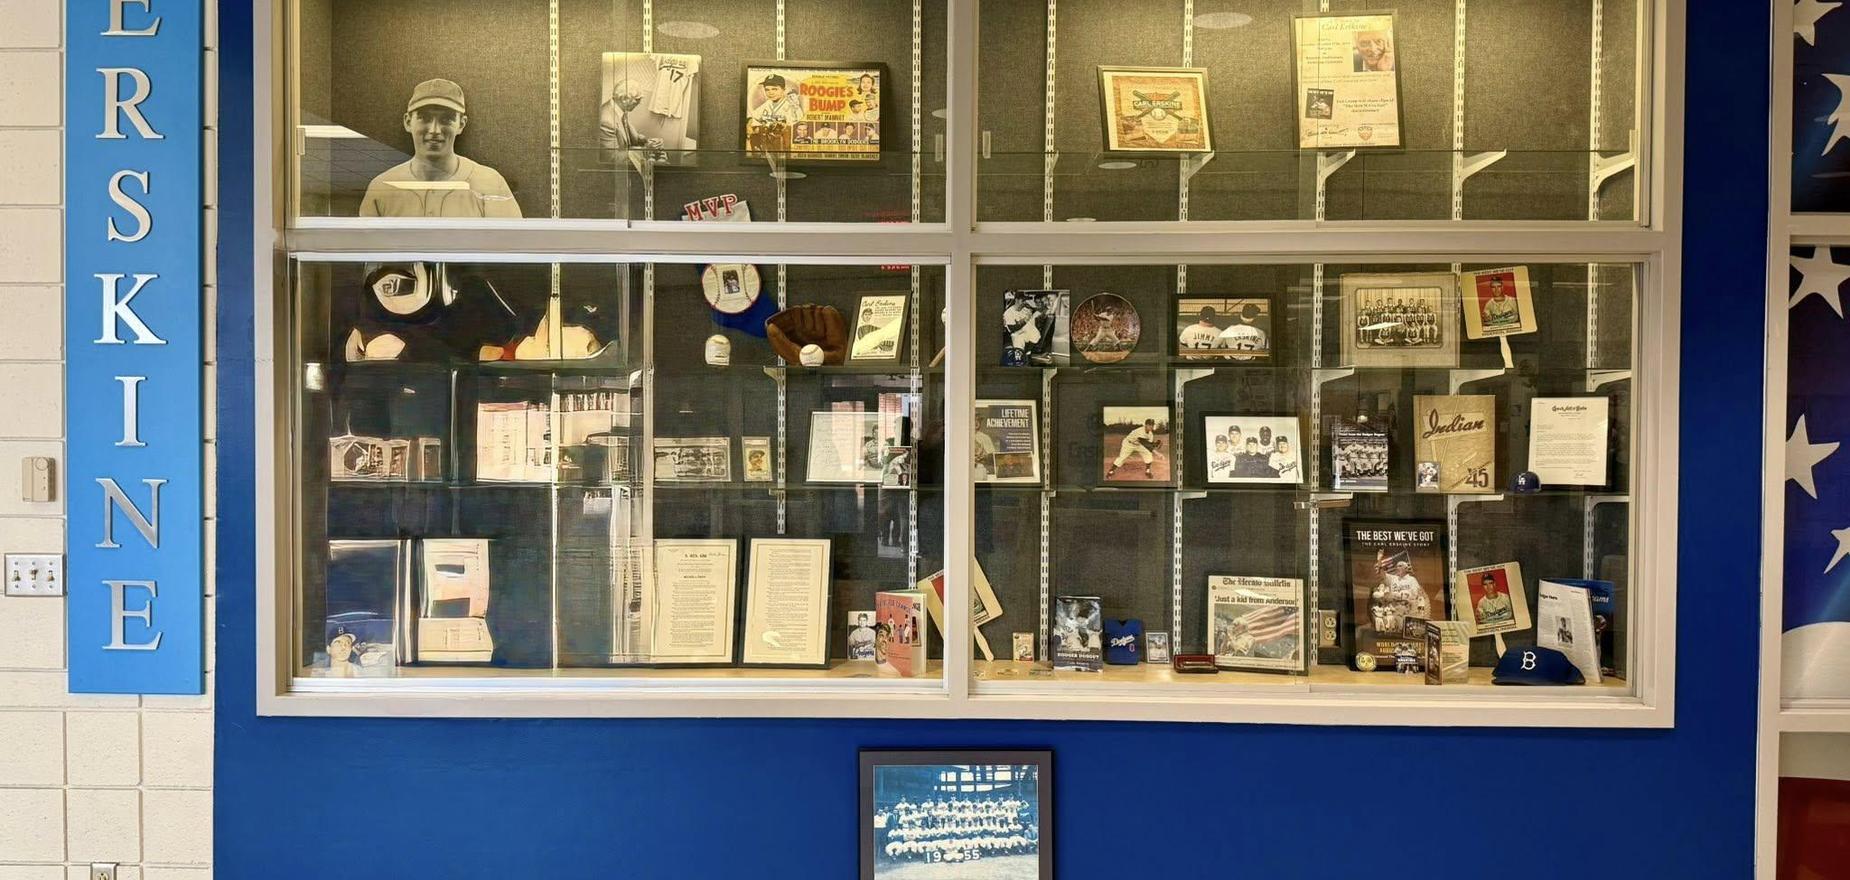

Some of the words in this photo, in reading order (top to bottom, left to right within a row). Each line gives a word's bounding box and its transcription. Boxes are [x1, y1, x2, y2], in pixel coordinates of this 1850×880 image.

[669, 69, 684, 83] 17
[809, 98, 846, 112] BUMP
[683, 193, 738, 222] MVP
[1001, 408, 1029, 418] LIFETIME
[986, 418, 1029, 428] ACHIEVEMENT
[1422, 408, 1486, 439] Indian
[1356, 530, 1372, 541] THE
[1373, 530, 1392, 541] BEST
[1394, 531, 1418, 541] WE'VE
[1419, 531, 1435, 542] GOT
[1222, 577, 1236, 586] The
[1236, 596, 1248, 604] kid
[1520, 651, 1537, 671] B
[926, 851, 942, 863] 19
[964, 850, 980, 861] 55
